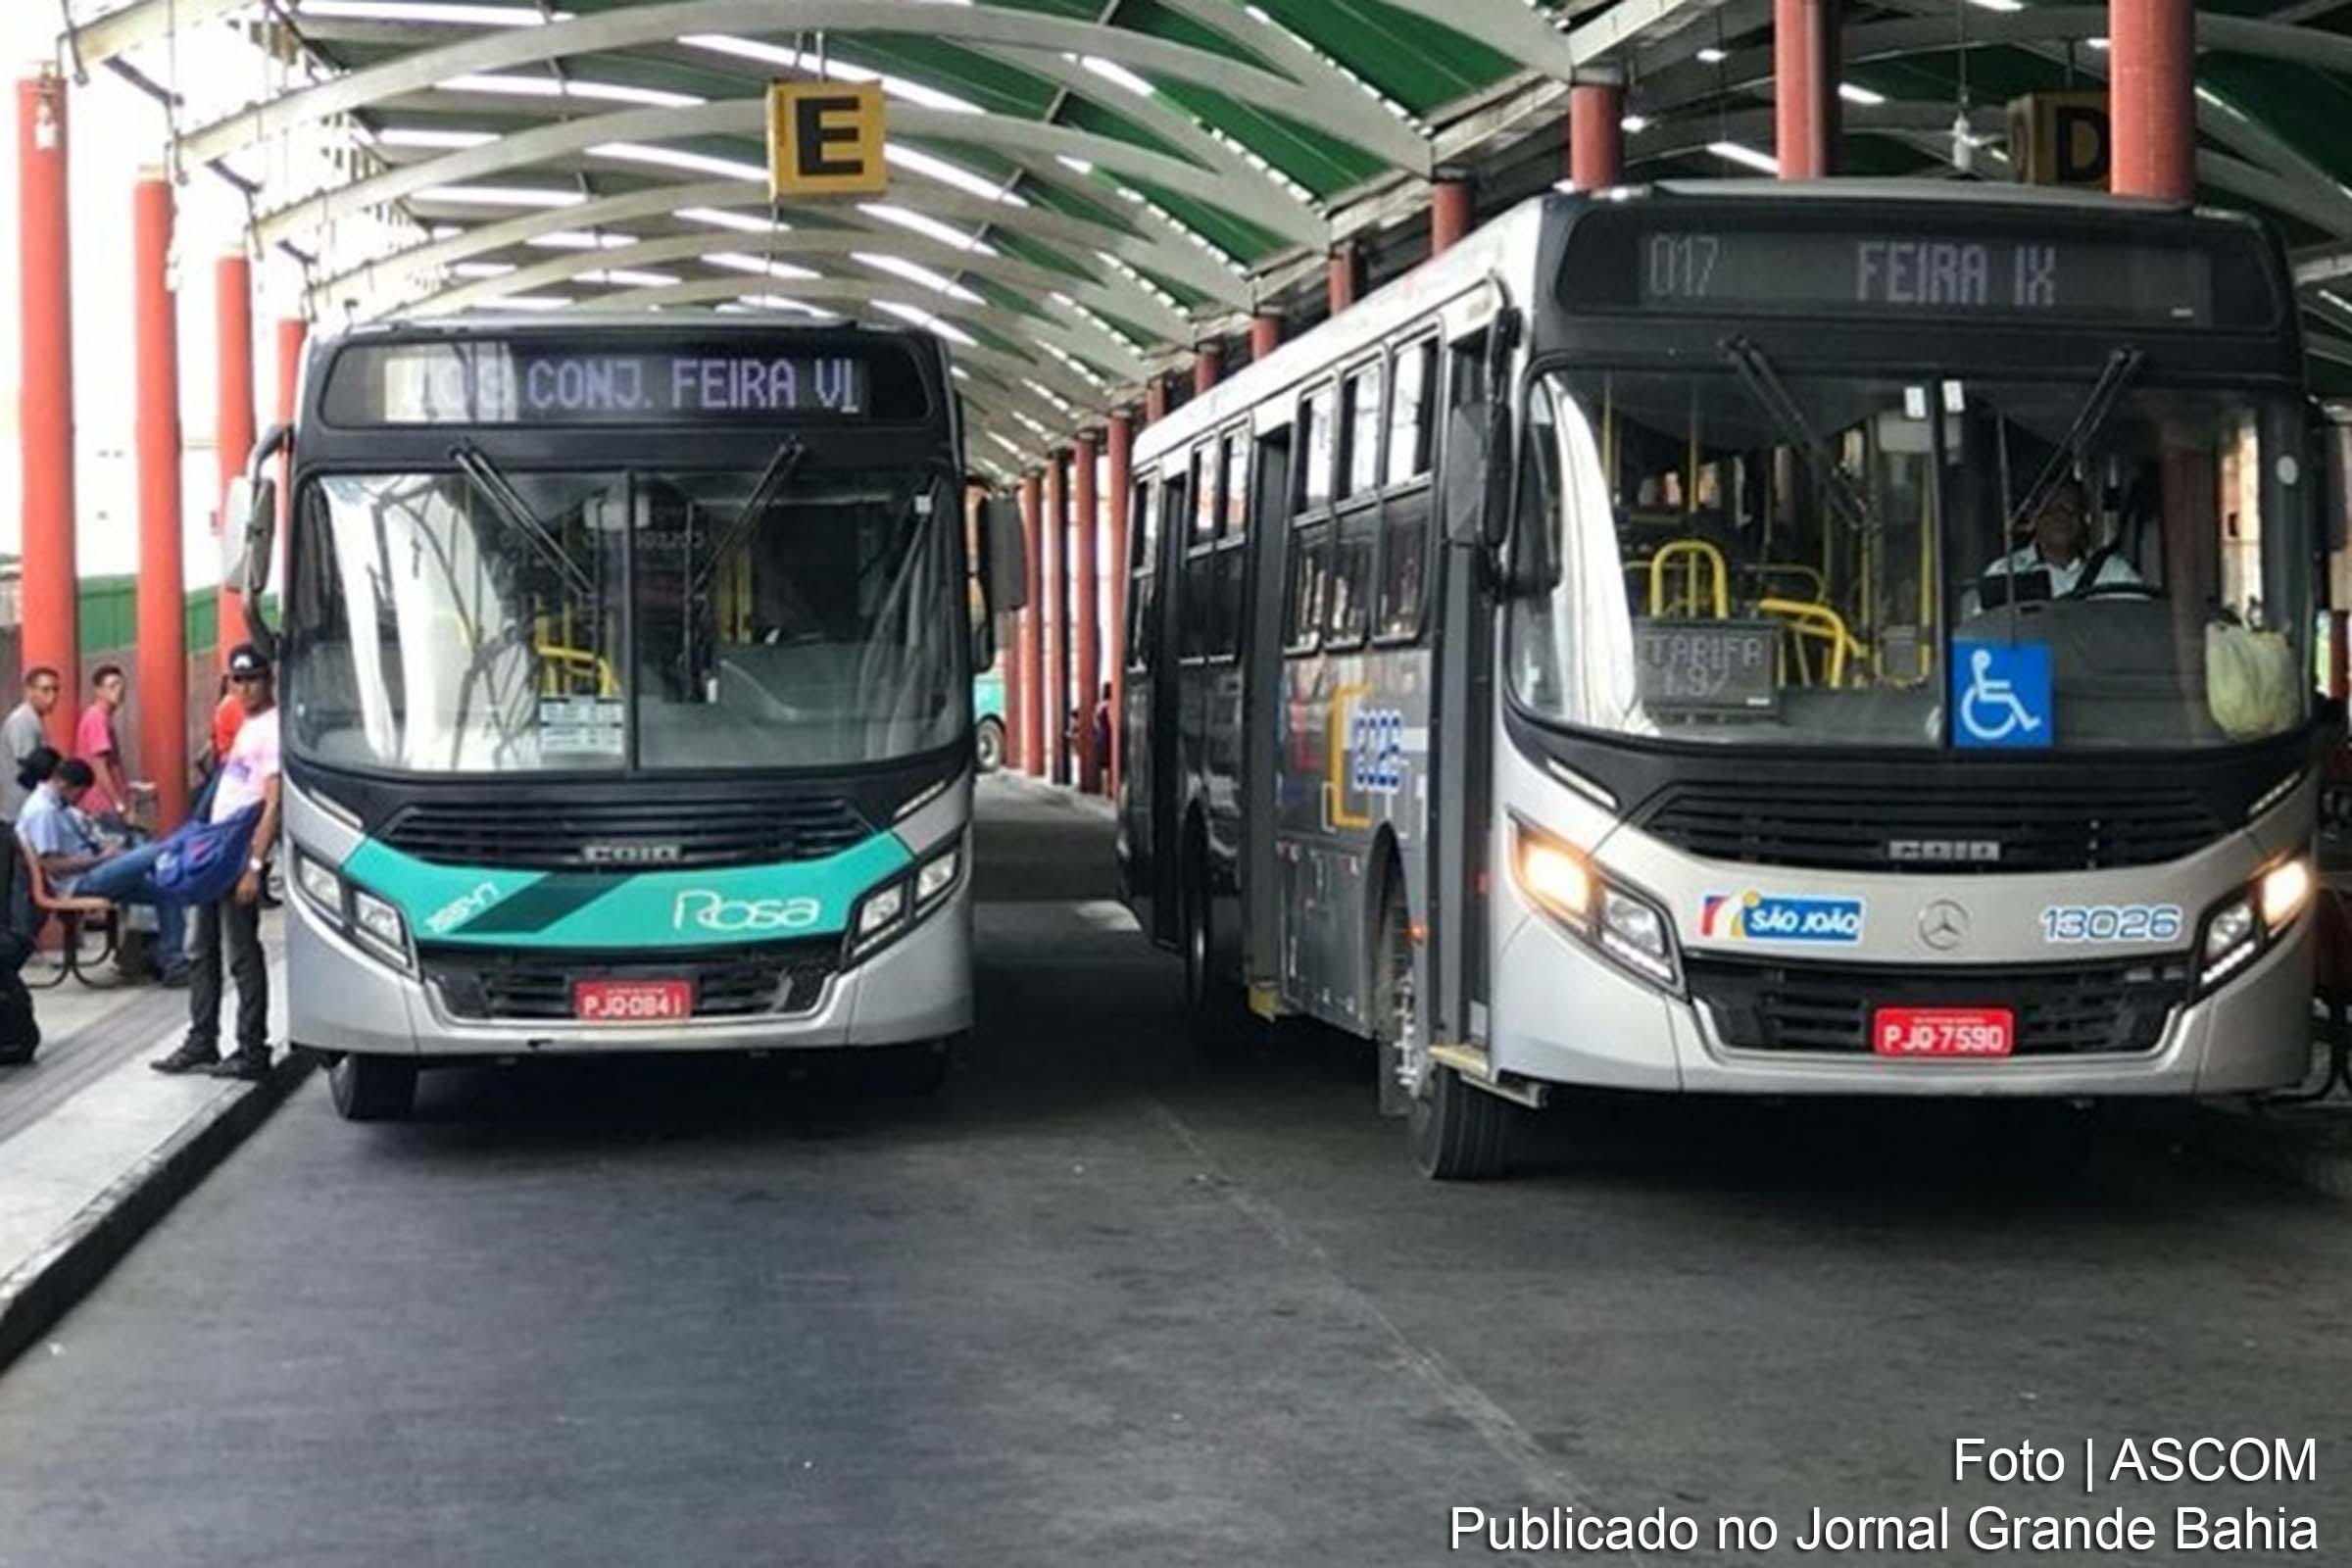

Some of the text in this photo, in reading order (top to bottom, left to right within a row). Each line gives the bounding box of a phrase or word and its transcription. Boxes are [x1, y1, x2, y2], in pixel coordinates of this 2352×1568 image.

[797, 96, 863, 176] E
[2055, 105, 2109, 181] D
[1647, 234, 1720, 296] 017
[1857, 241, 2056, 306] FEIRA IX
[527, 359, 654, 409] CONJ.
[671, 358, 796, 410] FEIRA
[672, 890, 820, 931] Rosa
[1750, 906, 1861, 935] SÃO JOÃO
[2041, 906, 2180, 941] 13026
